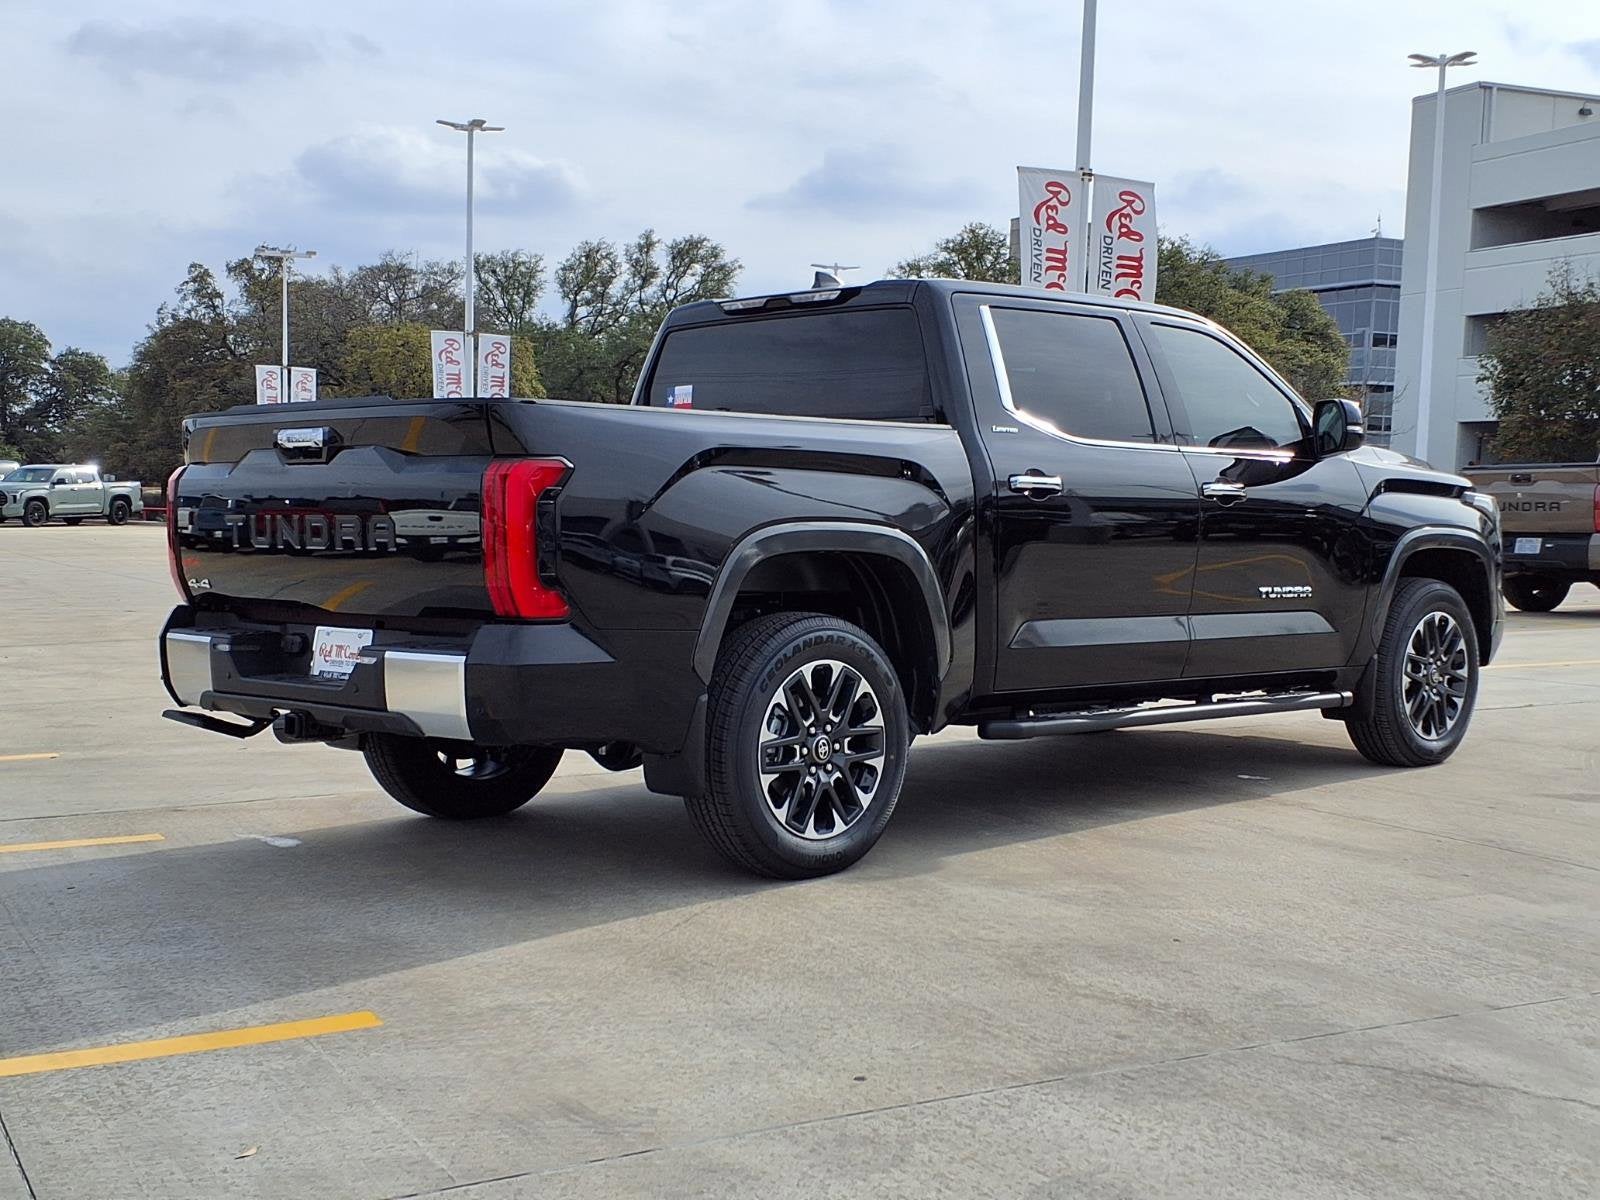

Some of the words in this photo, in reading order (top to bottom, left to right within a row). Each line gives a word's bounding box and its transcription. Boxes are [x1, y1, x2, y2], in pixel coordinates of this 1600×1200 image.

[1034, 181, 1071, 235] Red
[1106, 190, 1145, 242] Red
[1032, 227, 1042, 283] DRIVEN
[1101, 235, 1114, 290] DRIVEN
[438, 338, 461, 366] Red
[484, 341, 507, 369] Red
[1500, 502, 1561, 512] UNDRA
[223, 514, 397, 551] TUNDRA
[1258, 586, 1313, 598] TUNDRA
[319, 642, 333, 663] Red
[760, 634, 846, 693] GEOLANDAR
